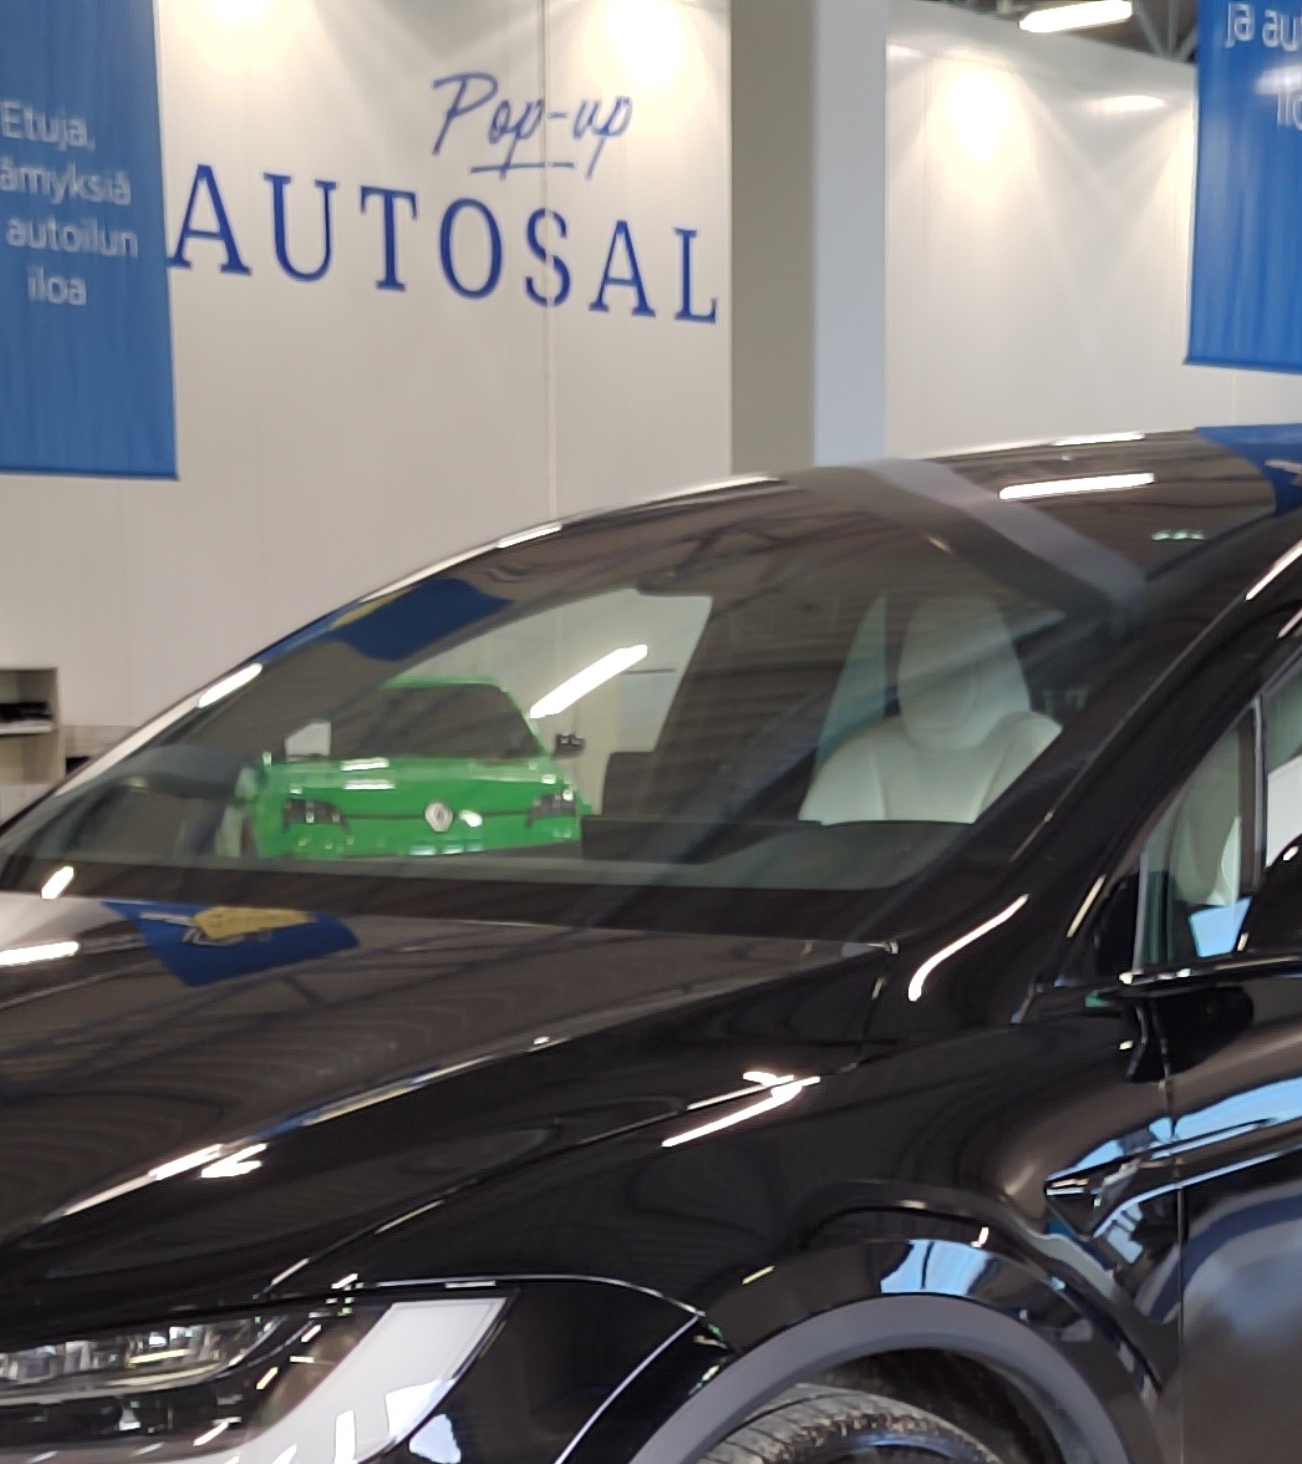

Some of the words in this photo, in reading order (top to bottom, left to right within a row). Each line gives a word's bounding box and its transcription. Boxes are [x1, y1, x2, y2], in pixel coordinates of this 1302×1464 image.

[431, 71, 633, 181] Pop-up
[5, 215, 139, 258] autoilun
[166, 163, 719, 324] AUTOSAL
[26, 264, 88, 306] iloa
